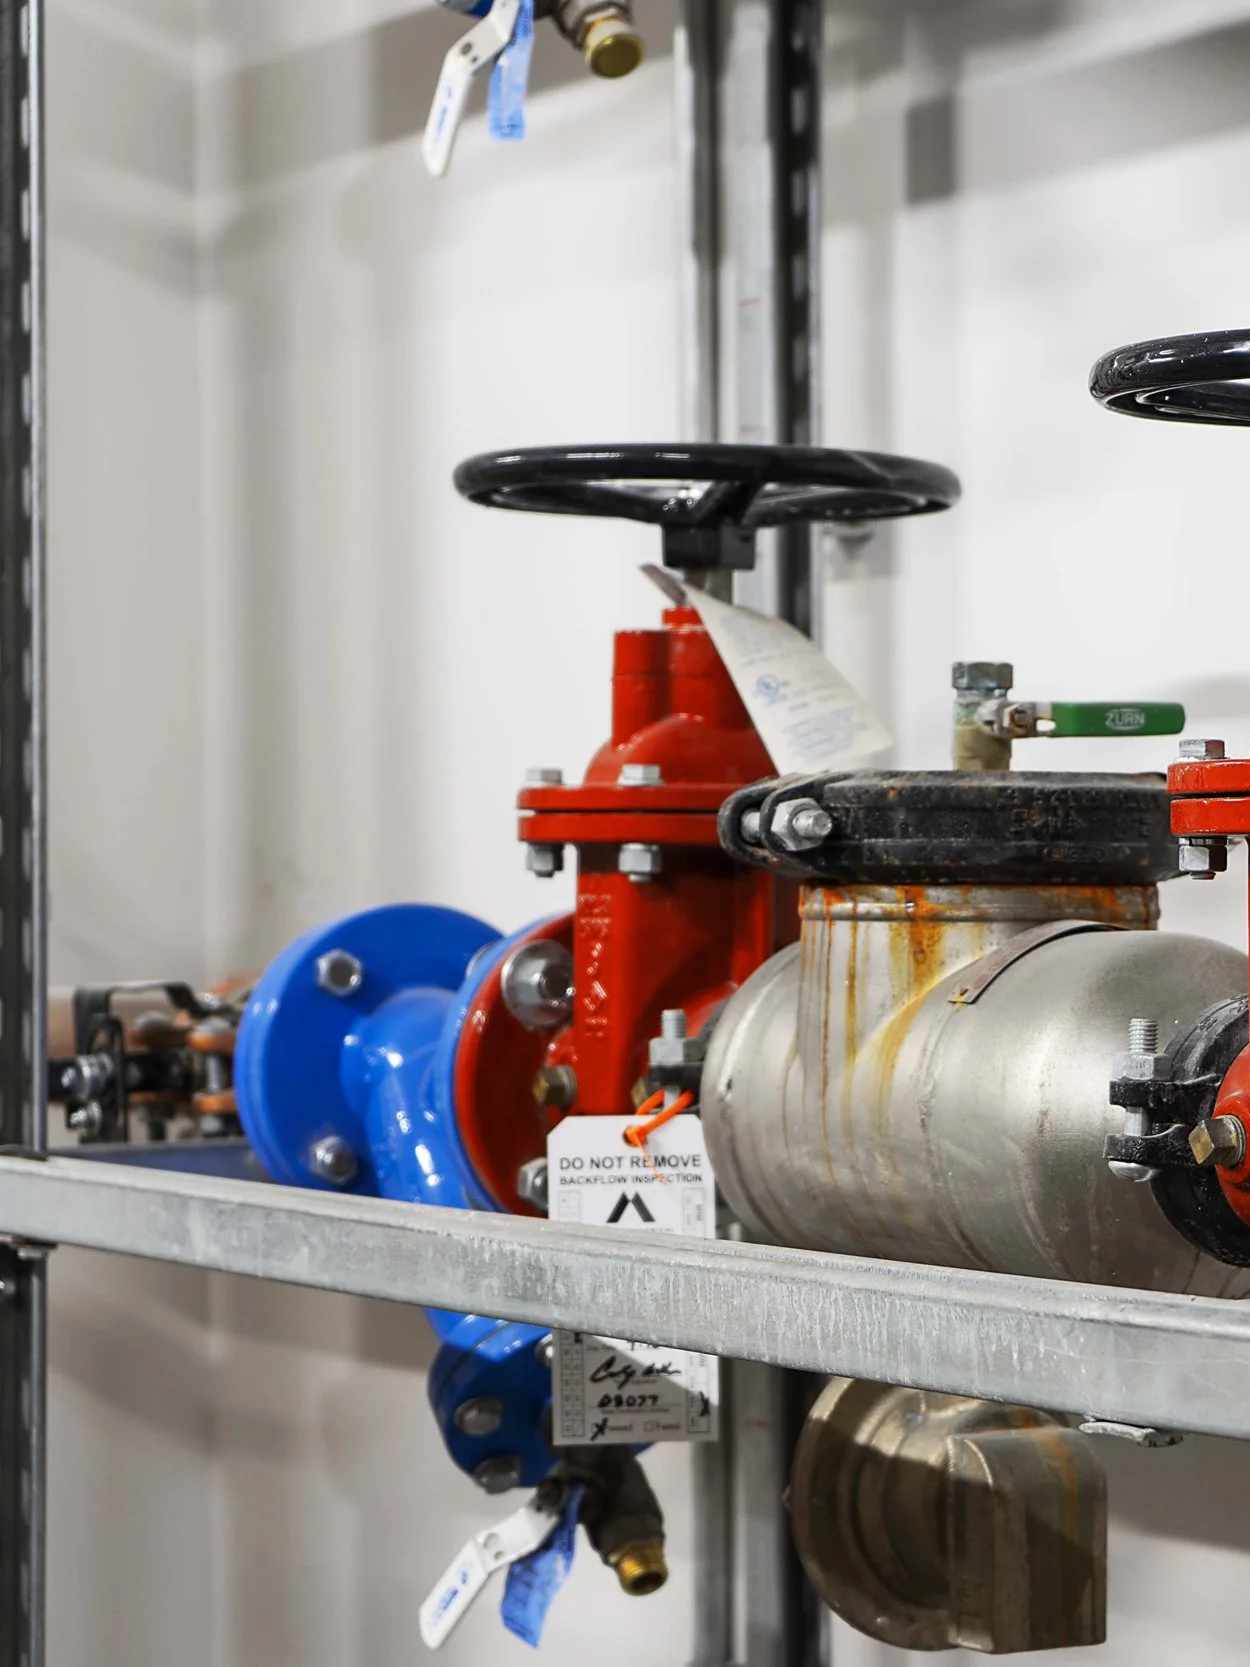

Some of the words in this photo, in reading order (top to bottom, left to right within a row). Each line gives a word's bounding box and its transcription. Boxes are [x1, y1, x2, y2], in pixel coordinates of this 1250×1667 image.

[1105, 712, 1146, 726] ZURN
[560, 1157, 584, 1170] DO
[590, 1156, 624, 1169] NOT
[560, 1174, 627, 1185] BACKFLOW
